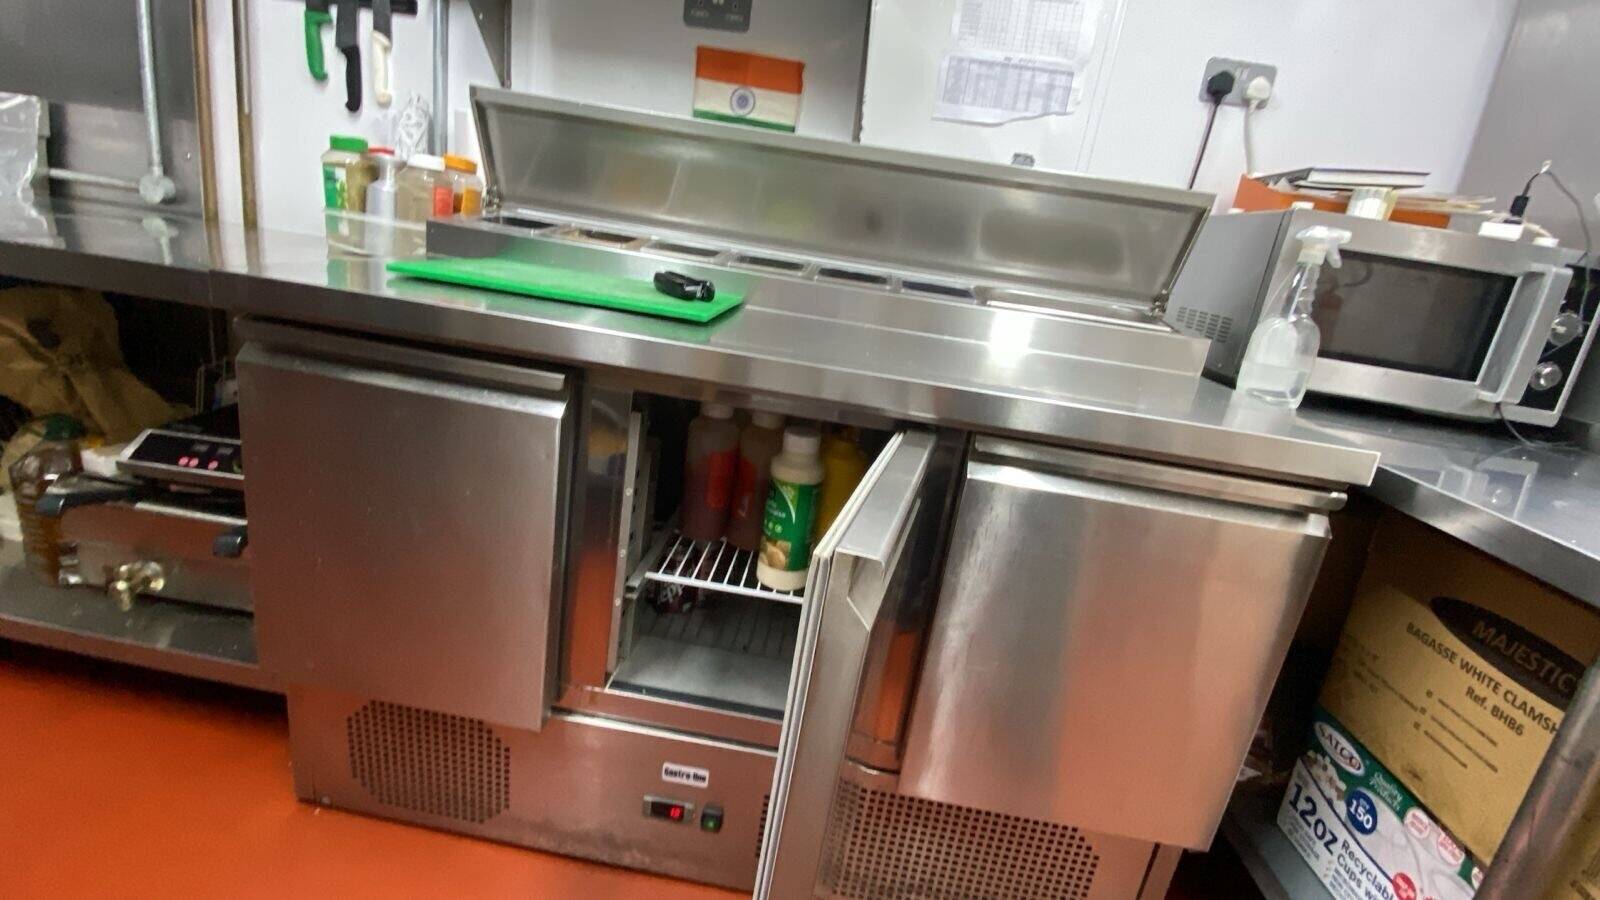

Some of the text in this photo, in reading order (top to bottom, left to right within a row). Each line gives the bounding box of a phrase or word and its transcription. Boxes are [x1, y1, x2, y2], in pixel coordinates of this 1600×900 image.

[1407, 622, 1458, 664] BAGASSE
[1460, 658, 1502, 694] WHITE
[1503, 690, 1560, 734] CLAMSH
[1472, 621, 1576, 692] MAJESTIC
[1465, 685, 1487, 709] Ref.
[1491, 705, 1525, 736] BHB6
[1349, 799, 1372, 829] 150
[1337, 853, 1362, 888] Cups
[1342, 839, 1394, 900] Recyclabl
